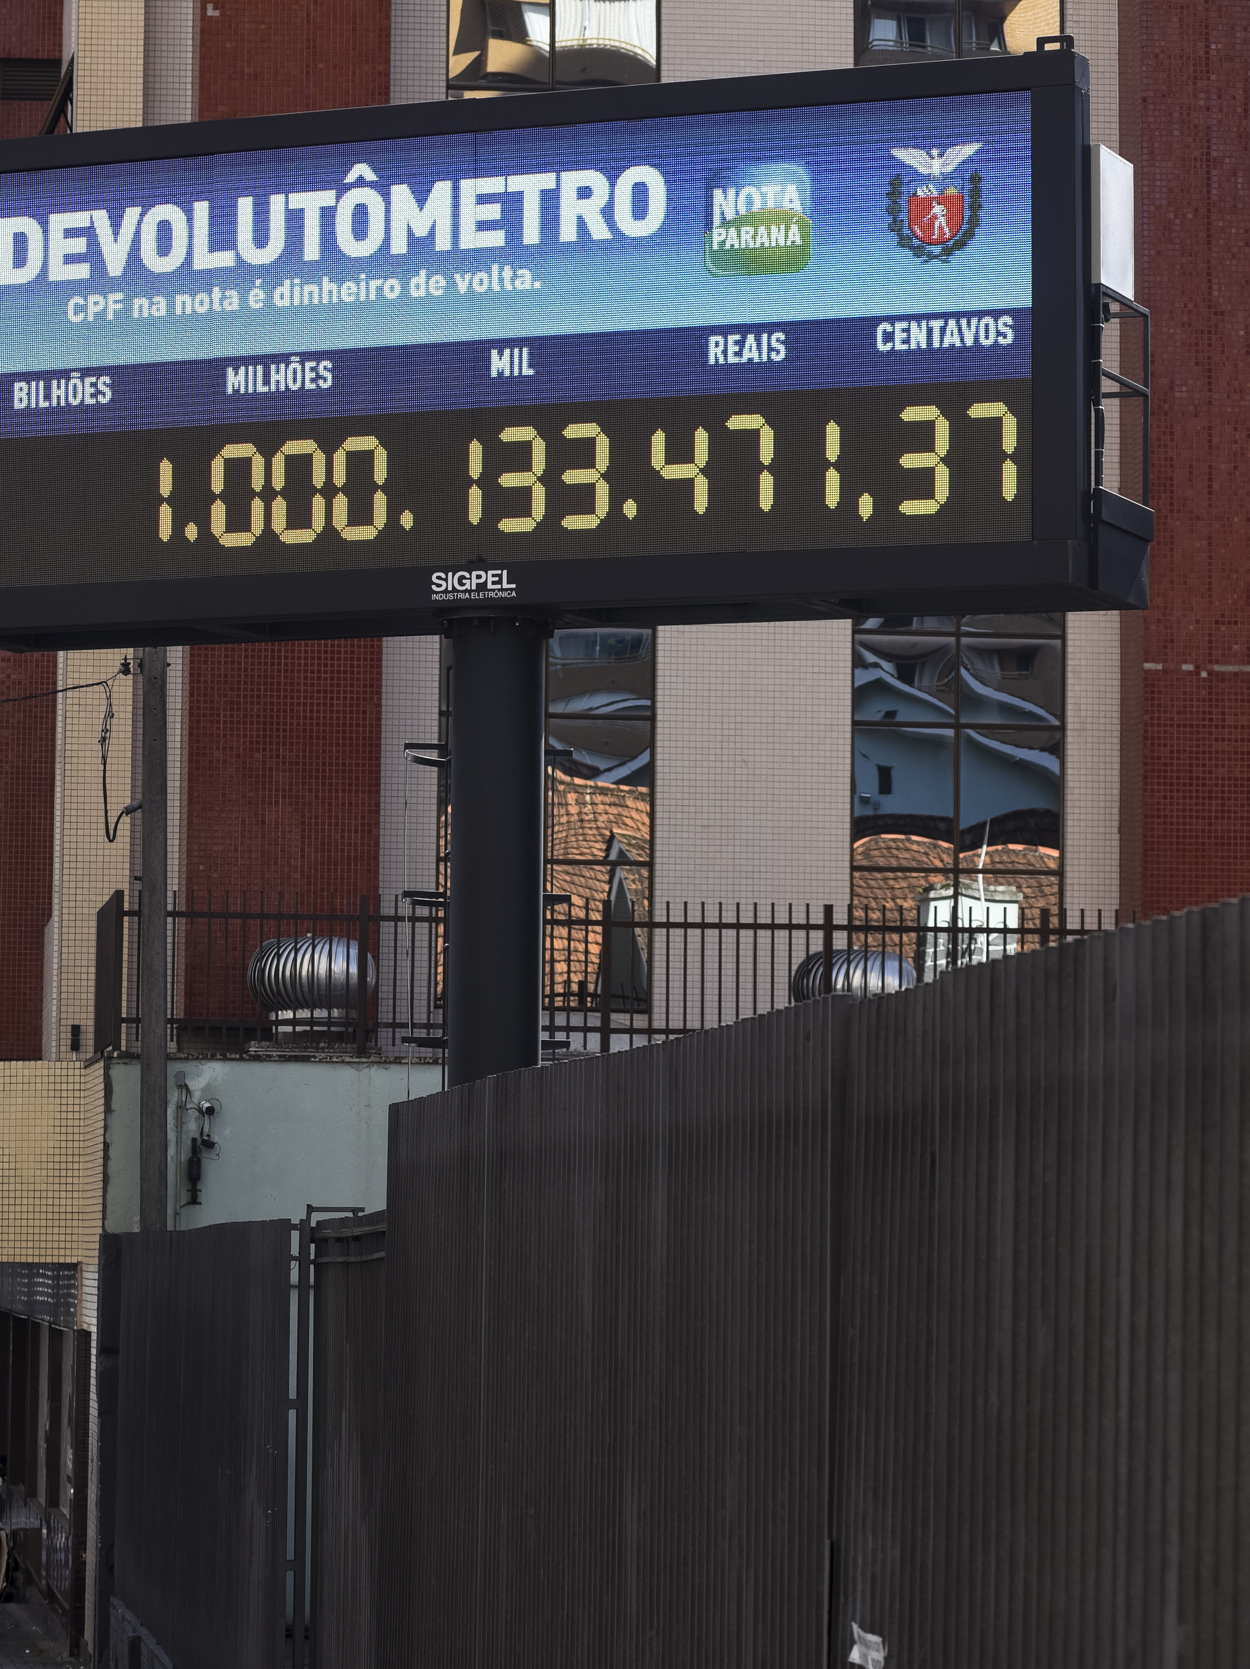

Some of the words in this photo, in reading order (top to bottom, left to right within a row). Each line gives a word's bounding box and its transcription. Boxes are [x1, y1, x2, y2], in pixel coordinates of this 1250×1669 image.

[712, 183, 804, 223] NOTA
[711, 217, 802, 251] PARANÁ
[67, 292, 124, 324] CPF
[132, 293, 168, 319] na
[175, 283, 241, 316] nota
[248, 277, 264, 310] é
[274, 270, 401, 308] dinheiro
[409, 268, 446, 299] de
[454, 264, 542, 295] volta.
[707, 332, 787, 365] REAIS
[876, 316, 1015, 353] CENTAVOS
[225, 357, 334, 397] MILHÕES
[490, 346, 536, 379] MIL
[13, 372, 113, 411] BILHÕES
[431, 570, 516, 591] SIGPEL
[431, 592, 470, 600] INDUSTRIA
[471, 590, 516, 599] ELETRÔNICA
